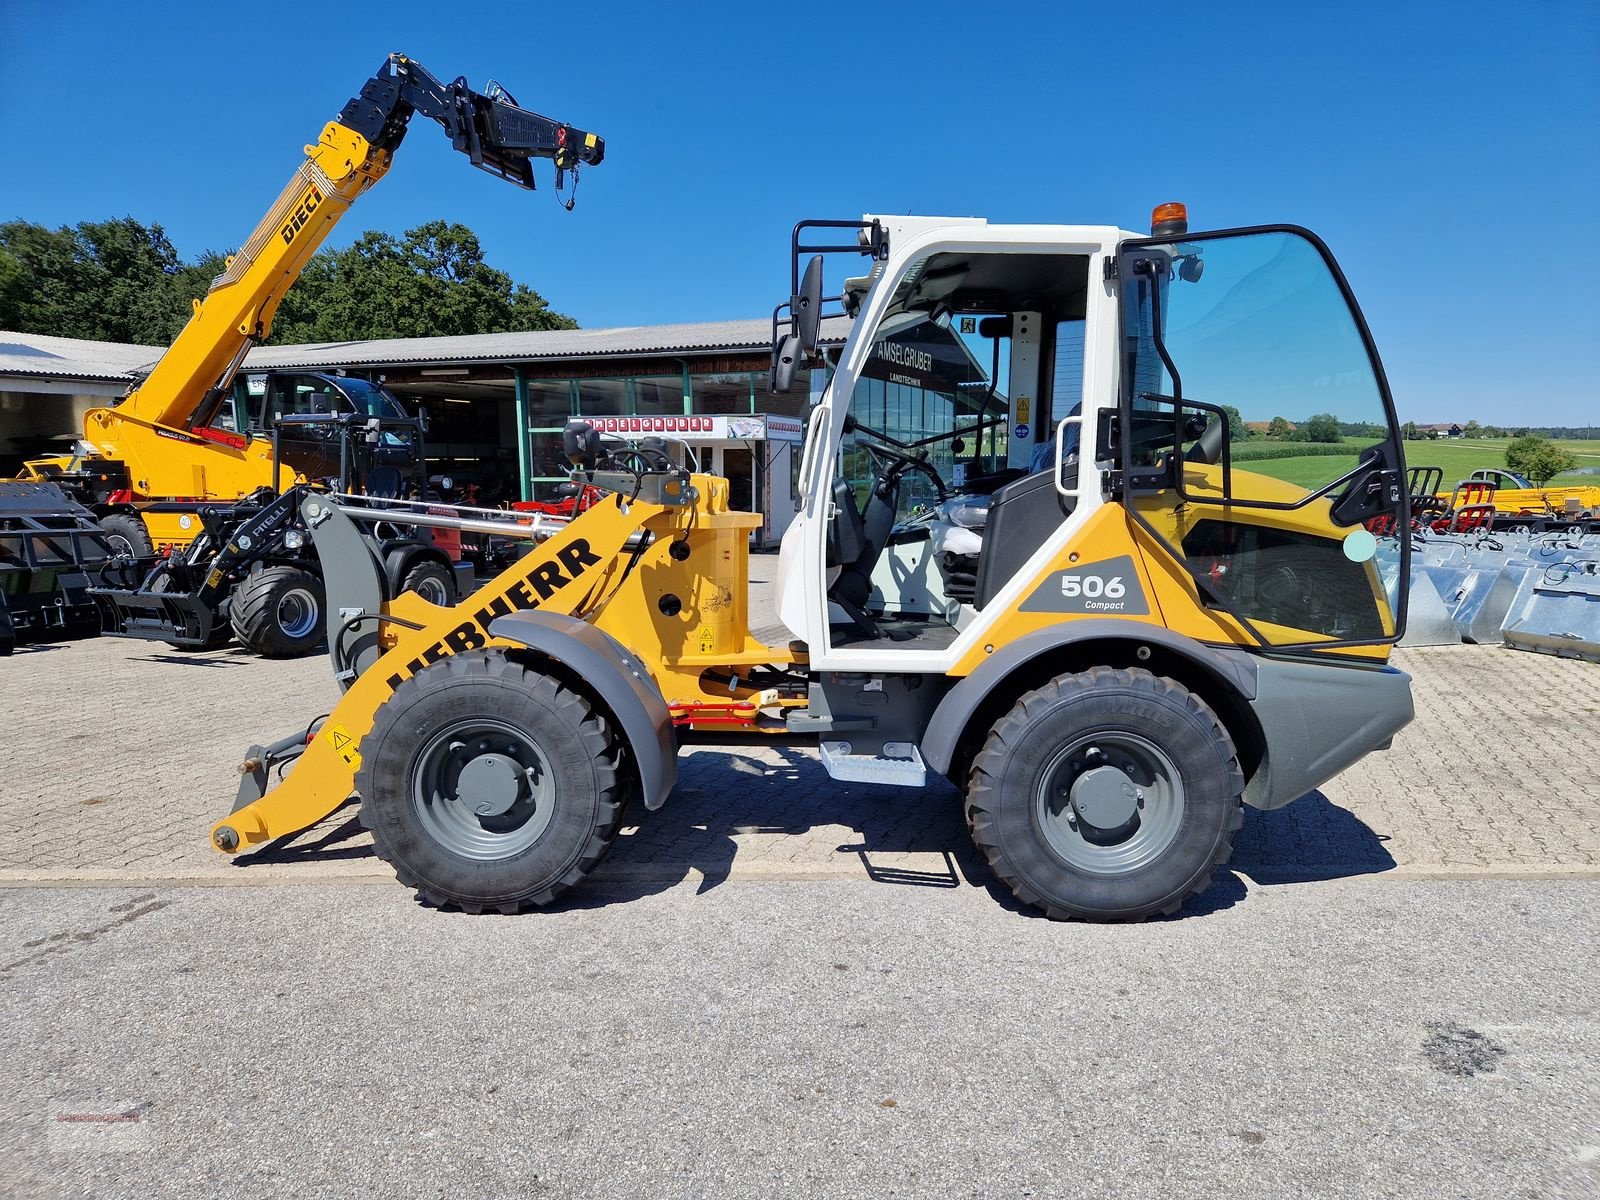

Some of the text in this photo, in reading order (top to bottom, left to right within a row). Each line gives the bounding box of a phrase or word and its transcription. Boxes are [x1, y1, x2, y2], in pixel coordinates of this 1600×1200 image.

[281, 186, 322, 245] DIECI
[878, 341, 932, 372] AMSELGRUBER
[252, 505, 288, 537] PITBULL
[1061, 575, 1126, 598] 506
[1085, 600, 1125, 611] Compact
